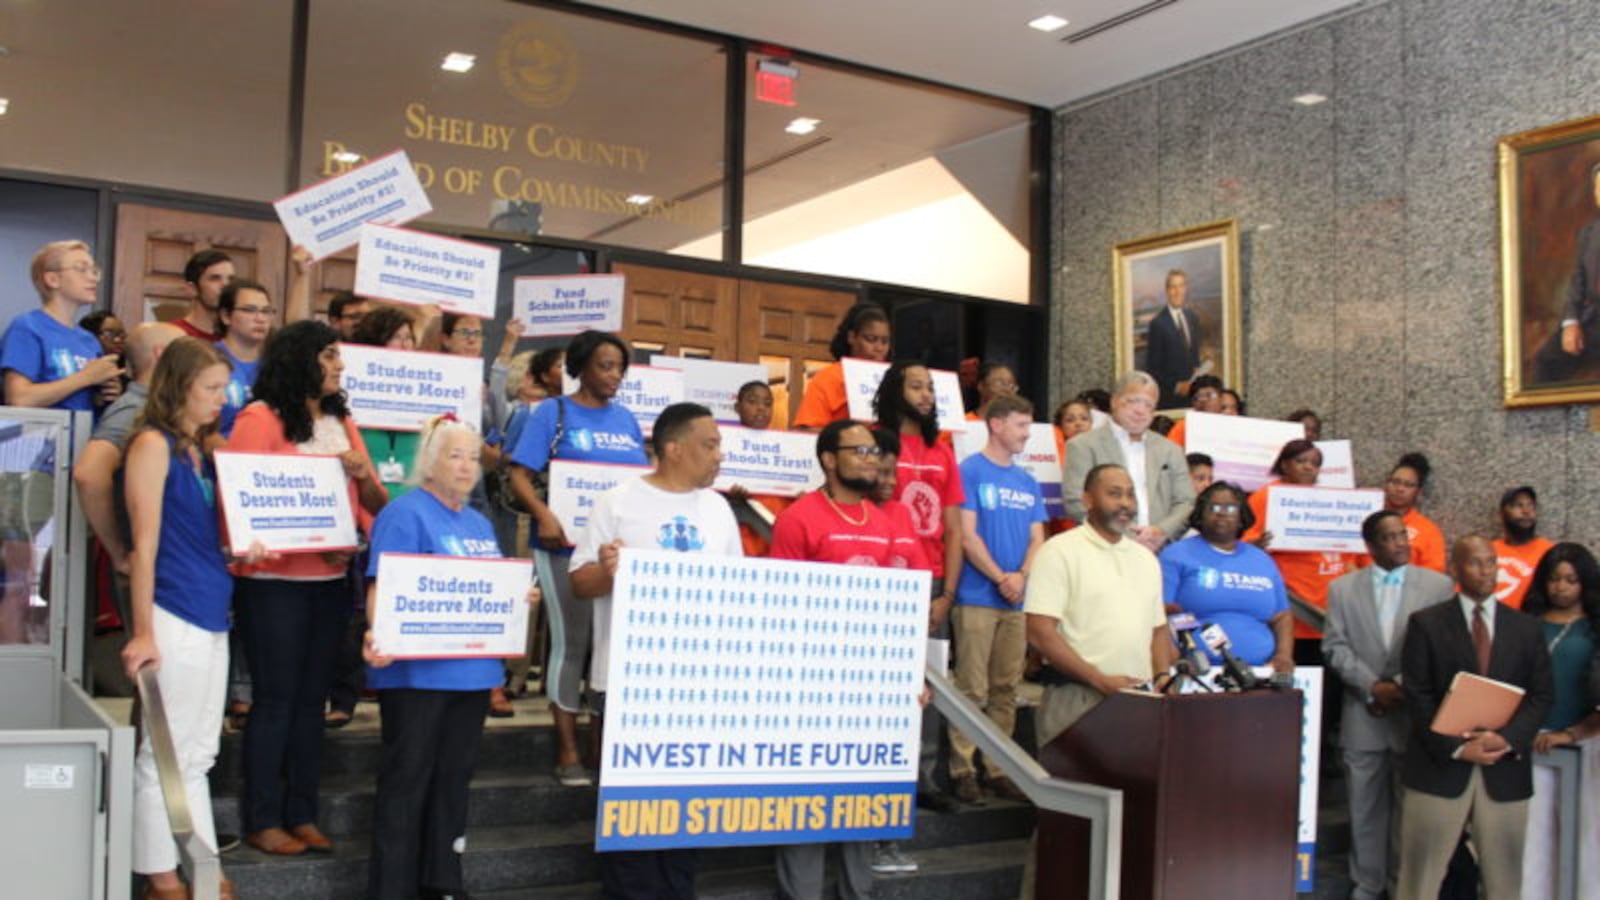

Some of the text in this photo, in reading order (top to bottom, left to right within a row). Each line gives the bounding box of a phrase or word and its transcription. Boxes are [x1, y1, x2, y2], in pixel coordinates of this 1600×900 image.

[405, 103, 650, 172] SHELBY COUNTY
[294, 167, 399, 216] Education Should
[311, 214, 326, 226] Be
[328, 195, 375, 218] Priority
[375, 238, 485, 269] Education Should
[384, 255, 399, 267] Be
[403, 259, 451, 279] Priority
[555, 287, 586, 299] Fund
[528, 298, 609, 312] Schools First!
[366, 362, 442, 382] Students
[345, 376, 465, 399] Deserve More!
[635, 393, 671, 406] First!
[742, 439, 780, 453] Fund
[773, 455, 812, 469] First!
[253, 471, 316, 488] Students
[239, 491, 336, 508] Deserve More!
[1280, 497, 1372, 511] Education Should
[1288, 511, 1301, 521] Be
[1304, 512, 1344, 526] Priority
[417, 576, 493, 594] Students
[1222, 571, 1273, 589] STAND
[394, 595, 514, 614] Deserve More!
[611, 743, 909, 768] INVEST IN THE FUTURE.
[601, 793, 913, 837] FUND STUDENTS FIRST!
